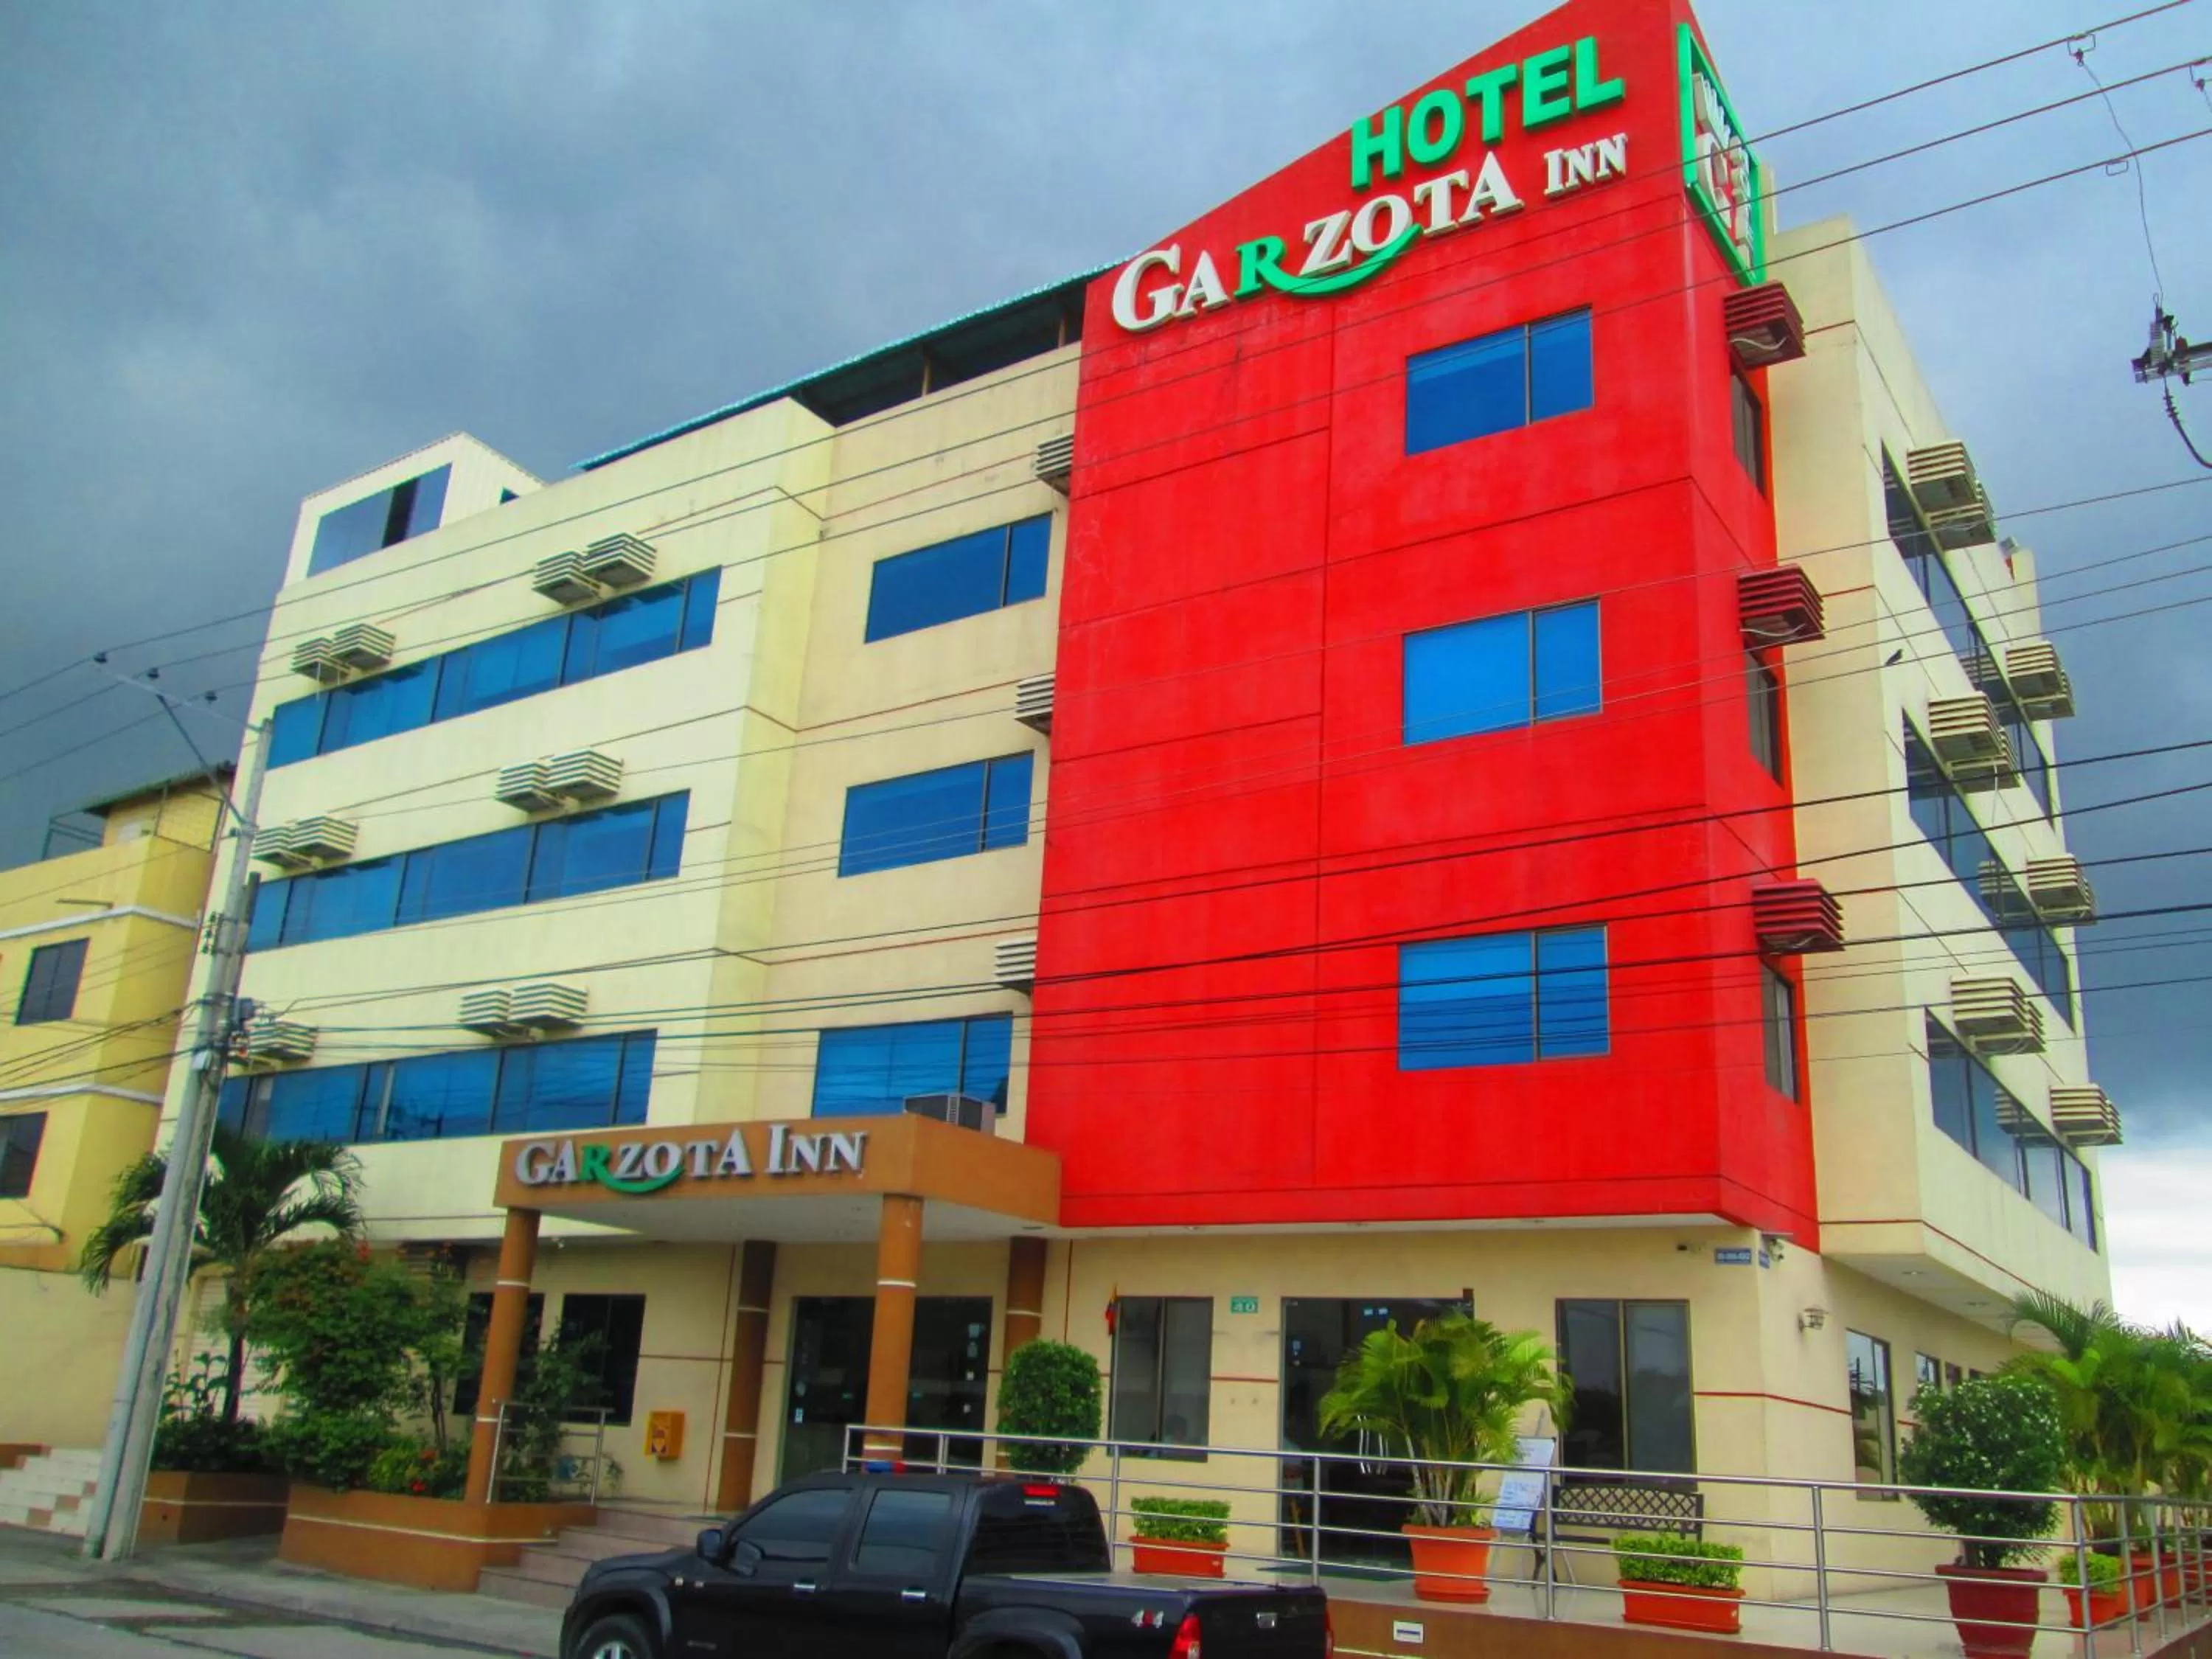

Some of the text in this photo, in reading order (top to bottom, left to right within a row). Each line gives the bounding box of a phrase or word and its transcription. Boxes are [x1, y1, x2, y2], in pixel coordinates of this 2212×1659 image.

[1350, 36, 1625, 189] HOTEL
[1112, 151, 1524, 333] GARZOTA
[1544, 133, 1628, 197] INN
[516, 1124, 869, 1194] GARZOTA INN
